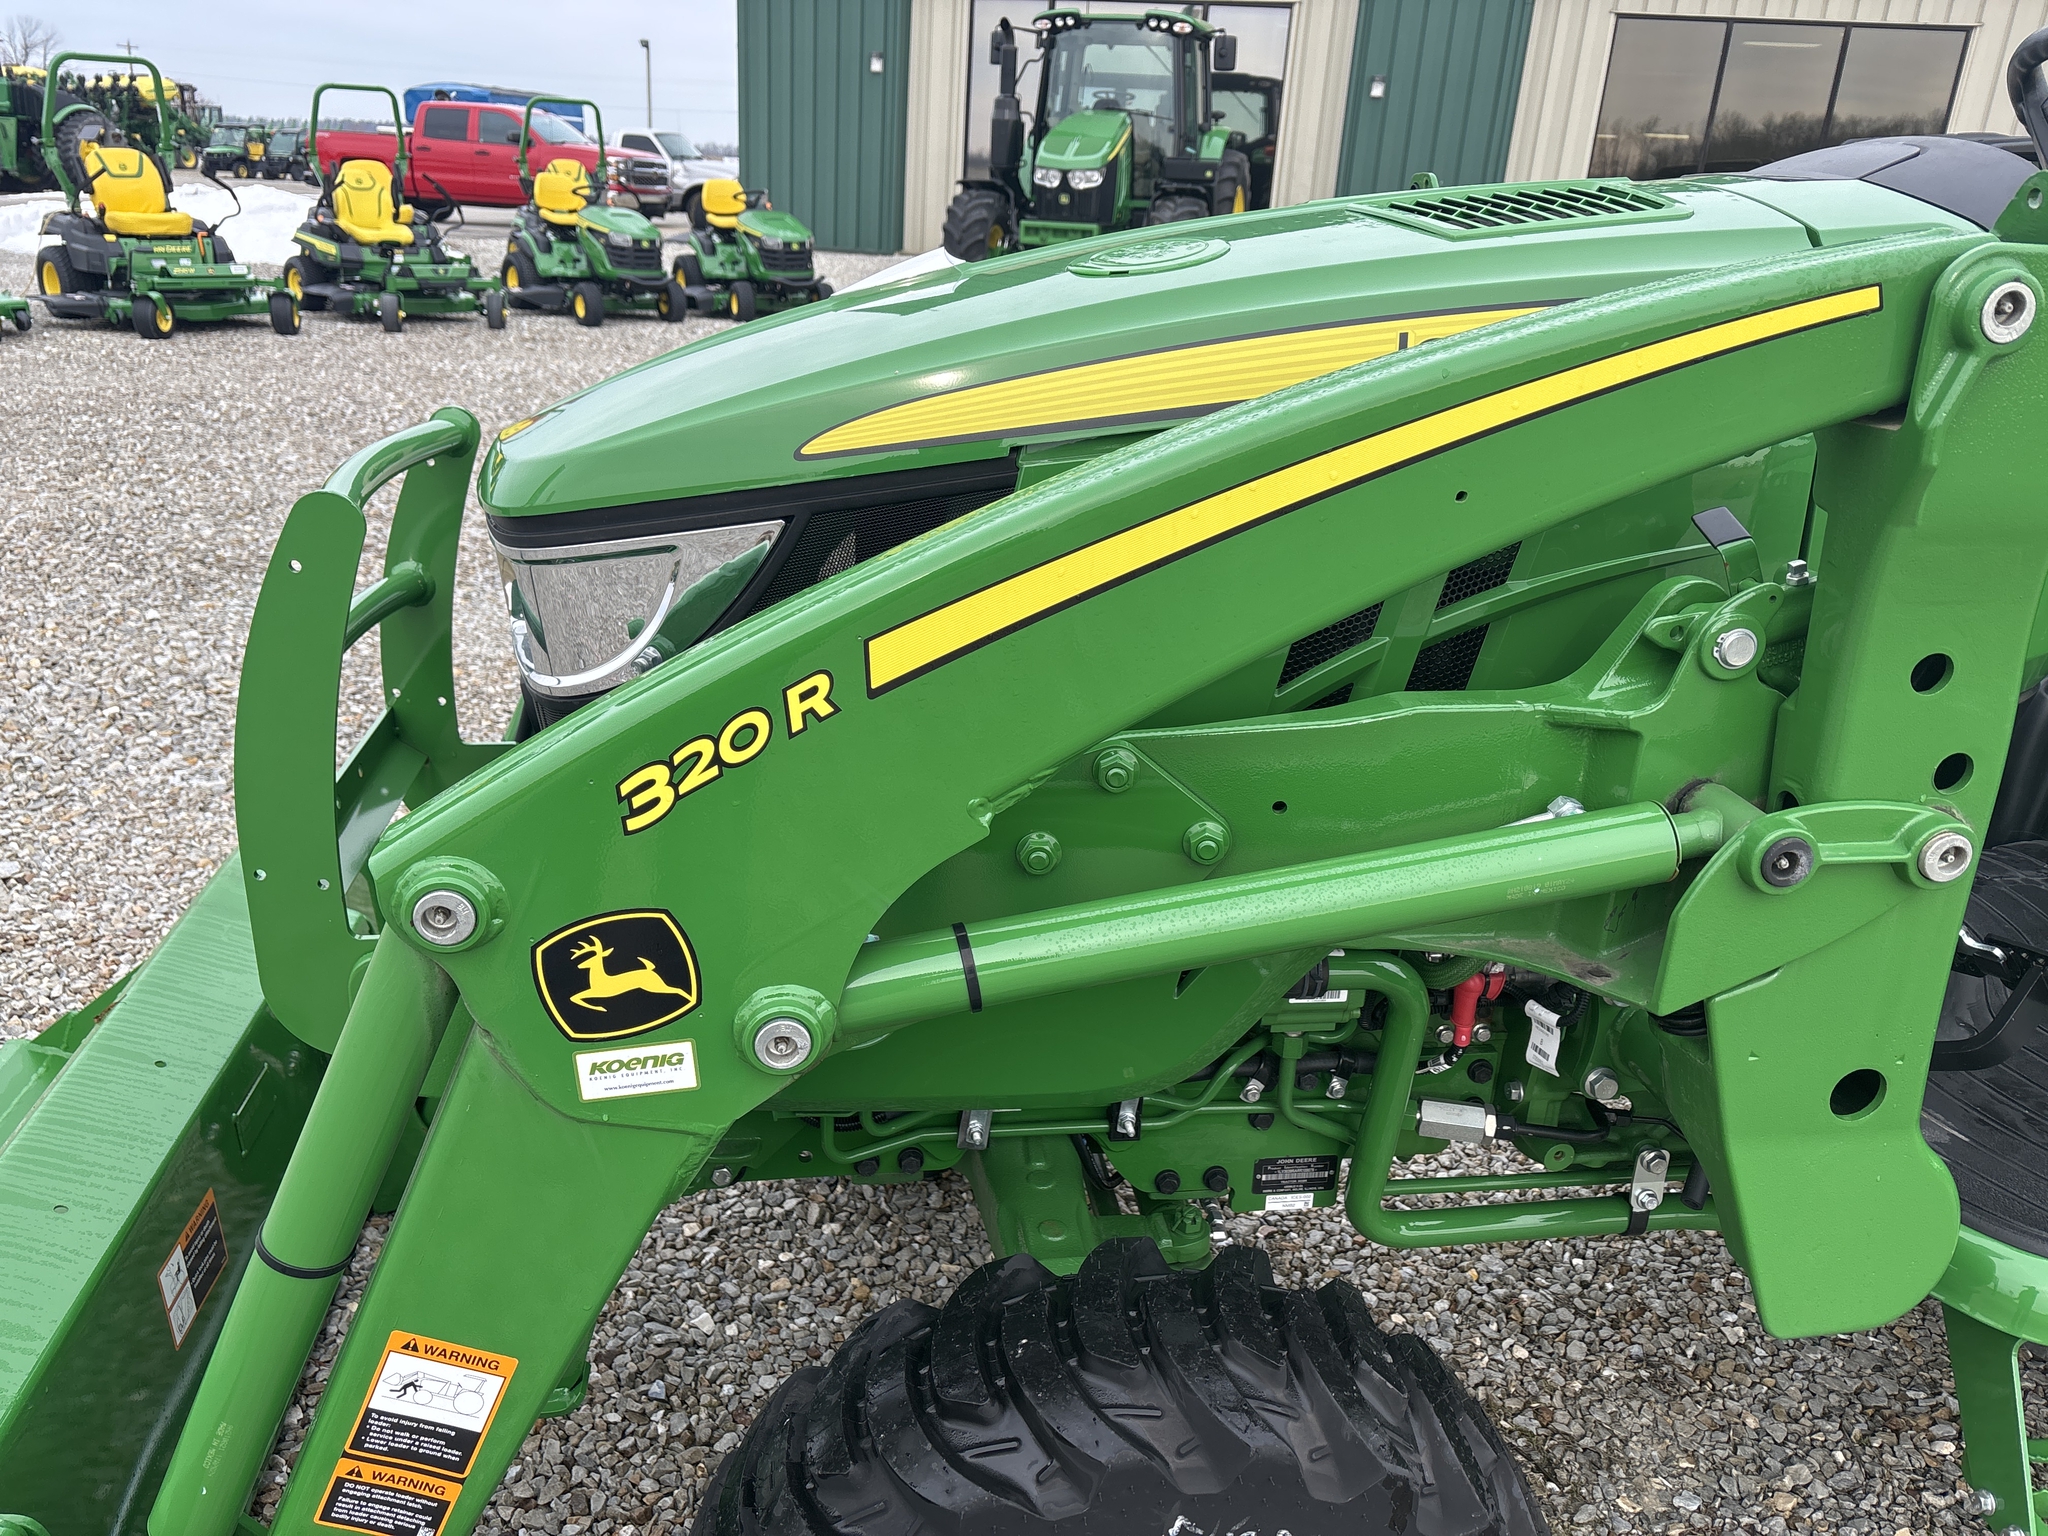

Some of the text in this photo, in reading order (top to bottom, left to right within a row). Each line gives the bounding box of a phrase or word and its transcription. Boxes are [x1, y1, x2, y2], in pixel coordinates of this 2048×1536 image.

[615, 669, 842, 836] 320 R
[622, 1070, 667, 1078] EQUIPMENT,
[604, 1079, 675, 1092] www.koenigequipment.com
[190, 1200, 210, 1233] WARNING
[424, 1344, 500, 1371] WARNING
[368, 1419, 392, 1428] loader:
[380, 1415, 398, 1423] avoid
[400, 1419, 418, 1428] injury
[419, 1421, 435, 1431] from
[436, 1427, 456, 1436] falling
[364, 1443, 389, 1452] parked.
[369, 1432, 394, 1440] service
[395, 1437, 414, 1445] under
[421, 1442, 441, 1451] raised
[442, 1447, 463, 1456] loader.
[395, 1430, 410, 1438] walk
[420, 1436, 446, 1446] perform
[367, 1437, 387, 1445] Lower
[388, 1442, 410, 1450] loader
[419, 1448, 442, 1457] ground
[443, 1453, 460, 1462] when
[372, 1470, 446, 1496] WARNING
[338, 1496, 359, 1505] Failure
[368, 1503, 390, 1512] engage
[391, 1507, 415, 1517] retainer
[415, 1512, 432, 1521] could
[342, 1488, 423, 1510] engaging attachment latch.
[371, 1488, 395, 1497] operate
[396, 1492, 415, 1501] loader
[416, 1497, 438, 1507] without
[331, 1512, 350, 1521] bodily
[351, 1516, 369, 1525] injury
[377, 1521, 395, 1530] death.
[334, 1507, 416, 1529] from loader causing serious
[336, 1502, 354, 1510] result
[362, 1507, 396, 1518] attachment
[397, 1513, 426, 1526] detaching
